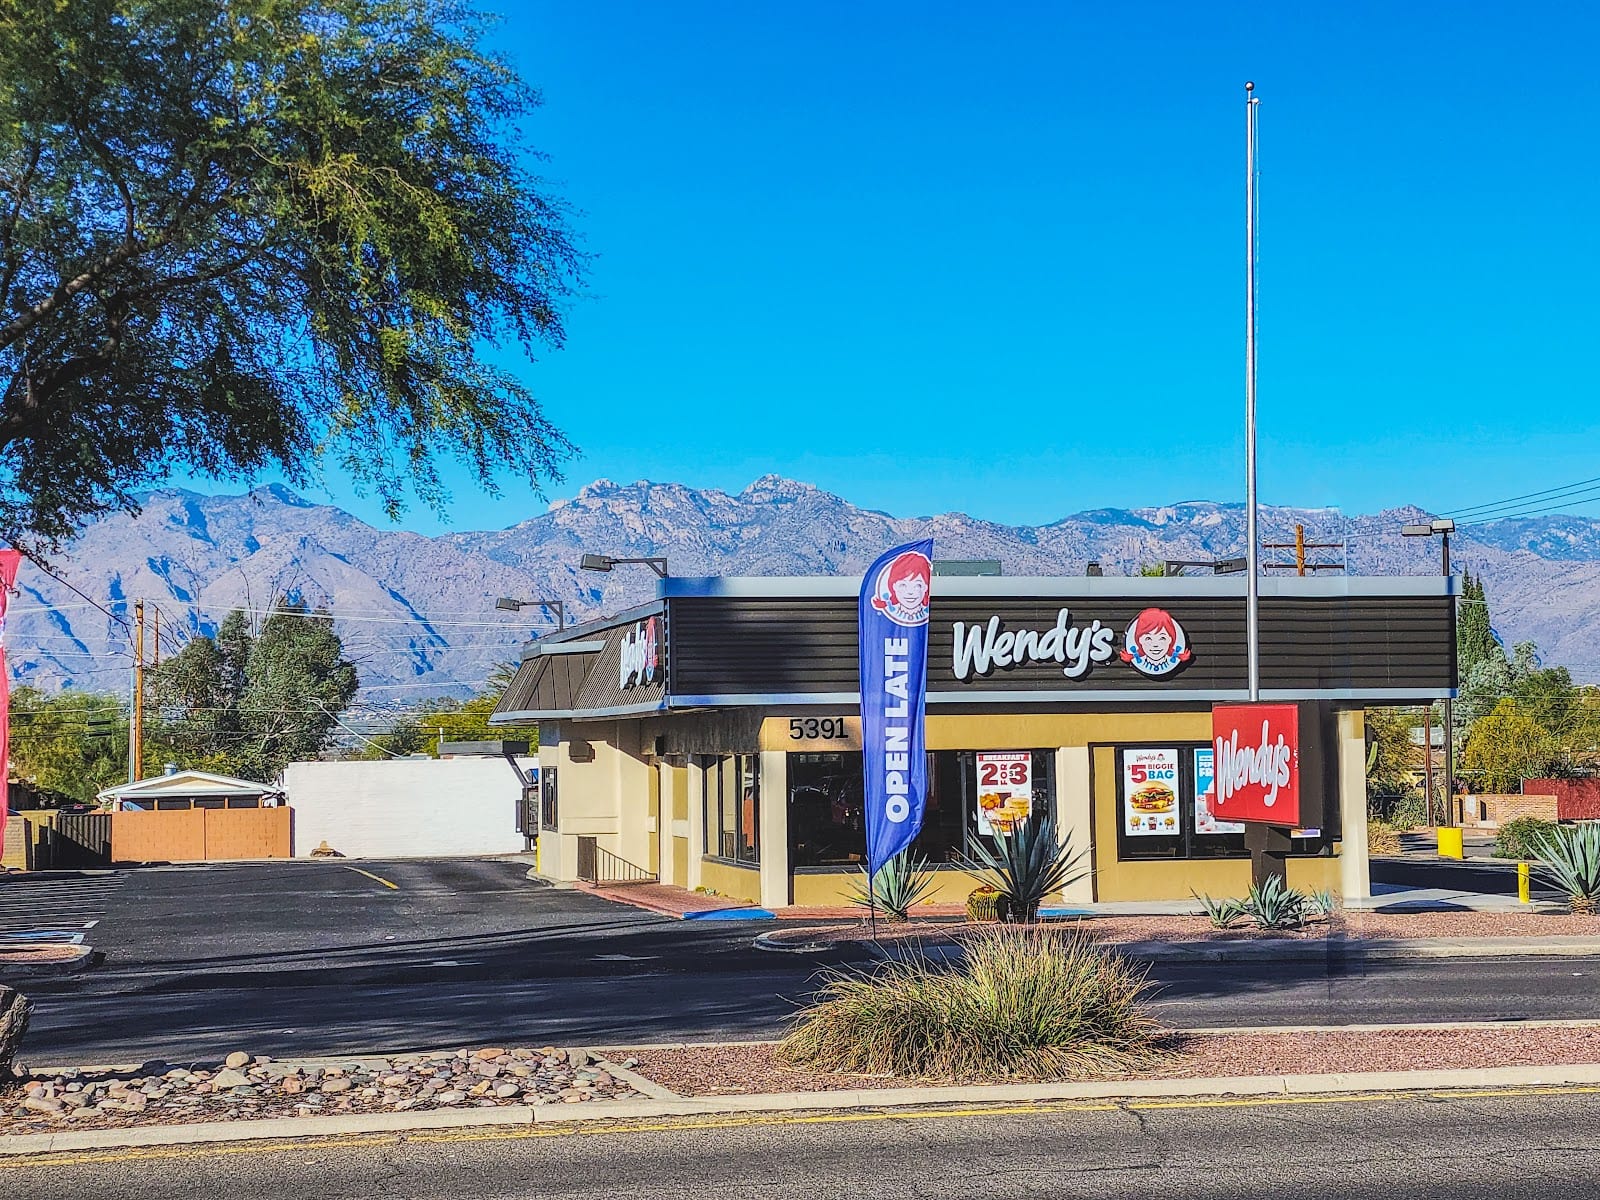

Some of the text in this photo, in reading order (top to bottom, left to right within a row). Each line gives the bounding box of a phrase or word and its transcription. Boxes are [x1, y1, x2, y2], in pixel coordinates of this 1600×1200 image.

[952, 607, 1114, 680] Wendy's
[789, 717, 849, 740] 5391
[884, 637, 910, 824] OPEN LATE
[980, 763, 999, 786] 2
[1000, 763, 1008, 786] FOR
[1148, 770, 1175, 780] BAG
[1216, 719, 1291, 807] Wendy's
